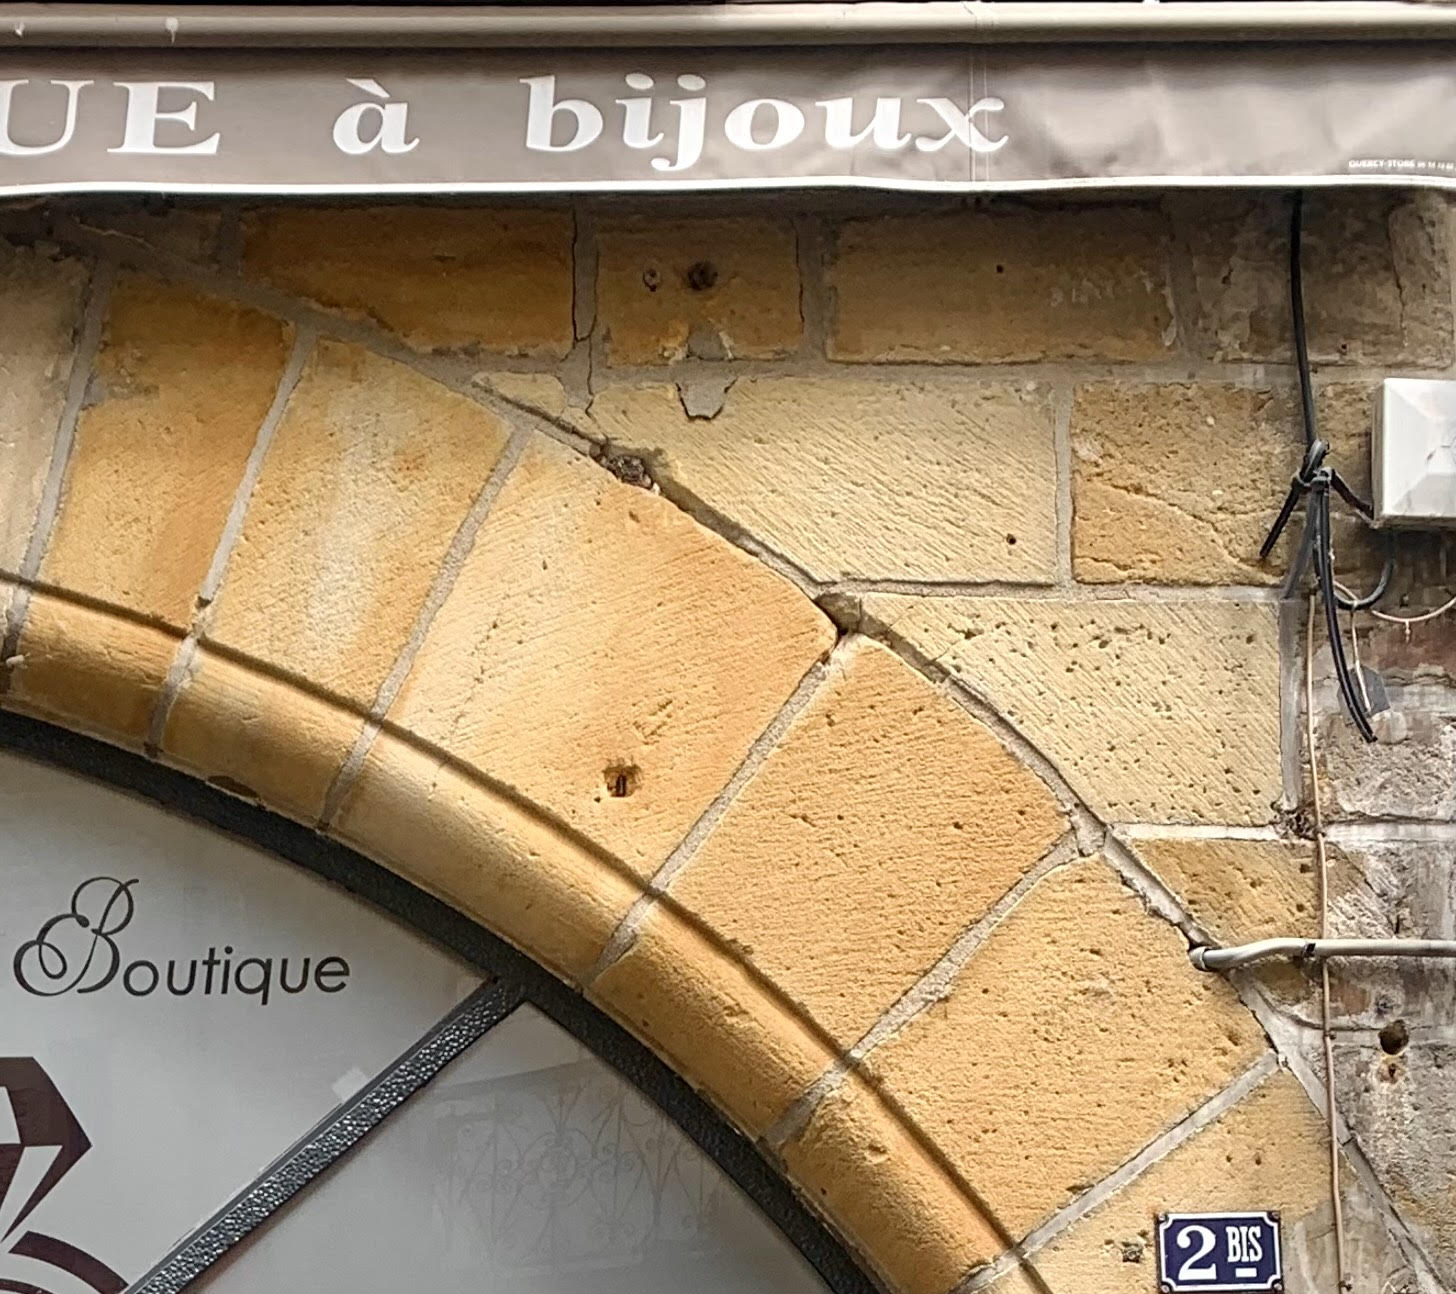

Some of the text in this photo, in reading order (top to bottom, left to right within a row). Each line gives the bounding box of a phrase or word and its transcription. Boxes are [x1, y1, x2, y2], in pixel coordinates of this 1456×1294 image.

[332, 77, 420, 154] à
[519, 72, 1010, 171] bijoux
[13, 876, 350, 1006] Boutique
[1176, 1224, 1264, 1281] 2 BIS
